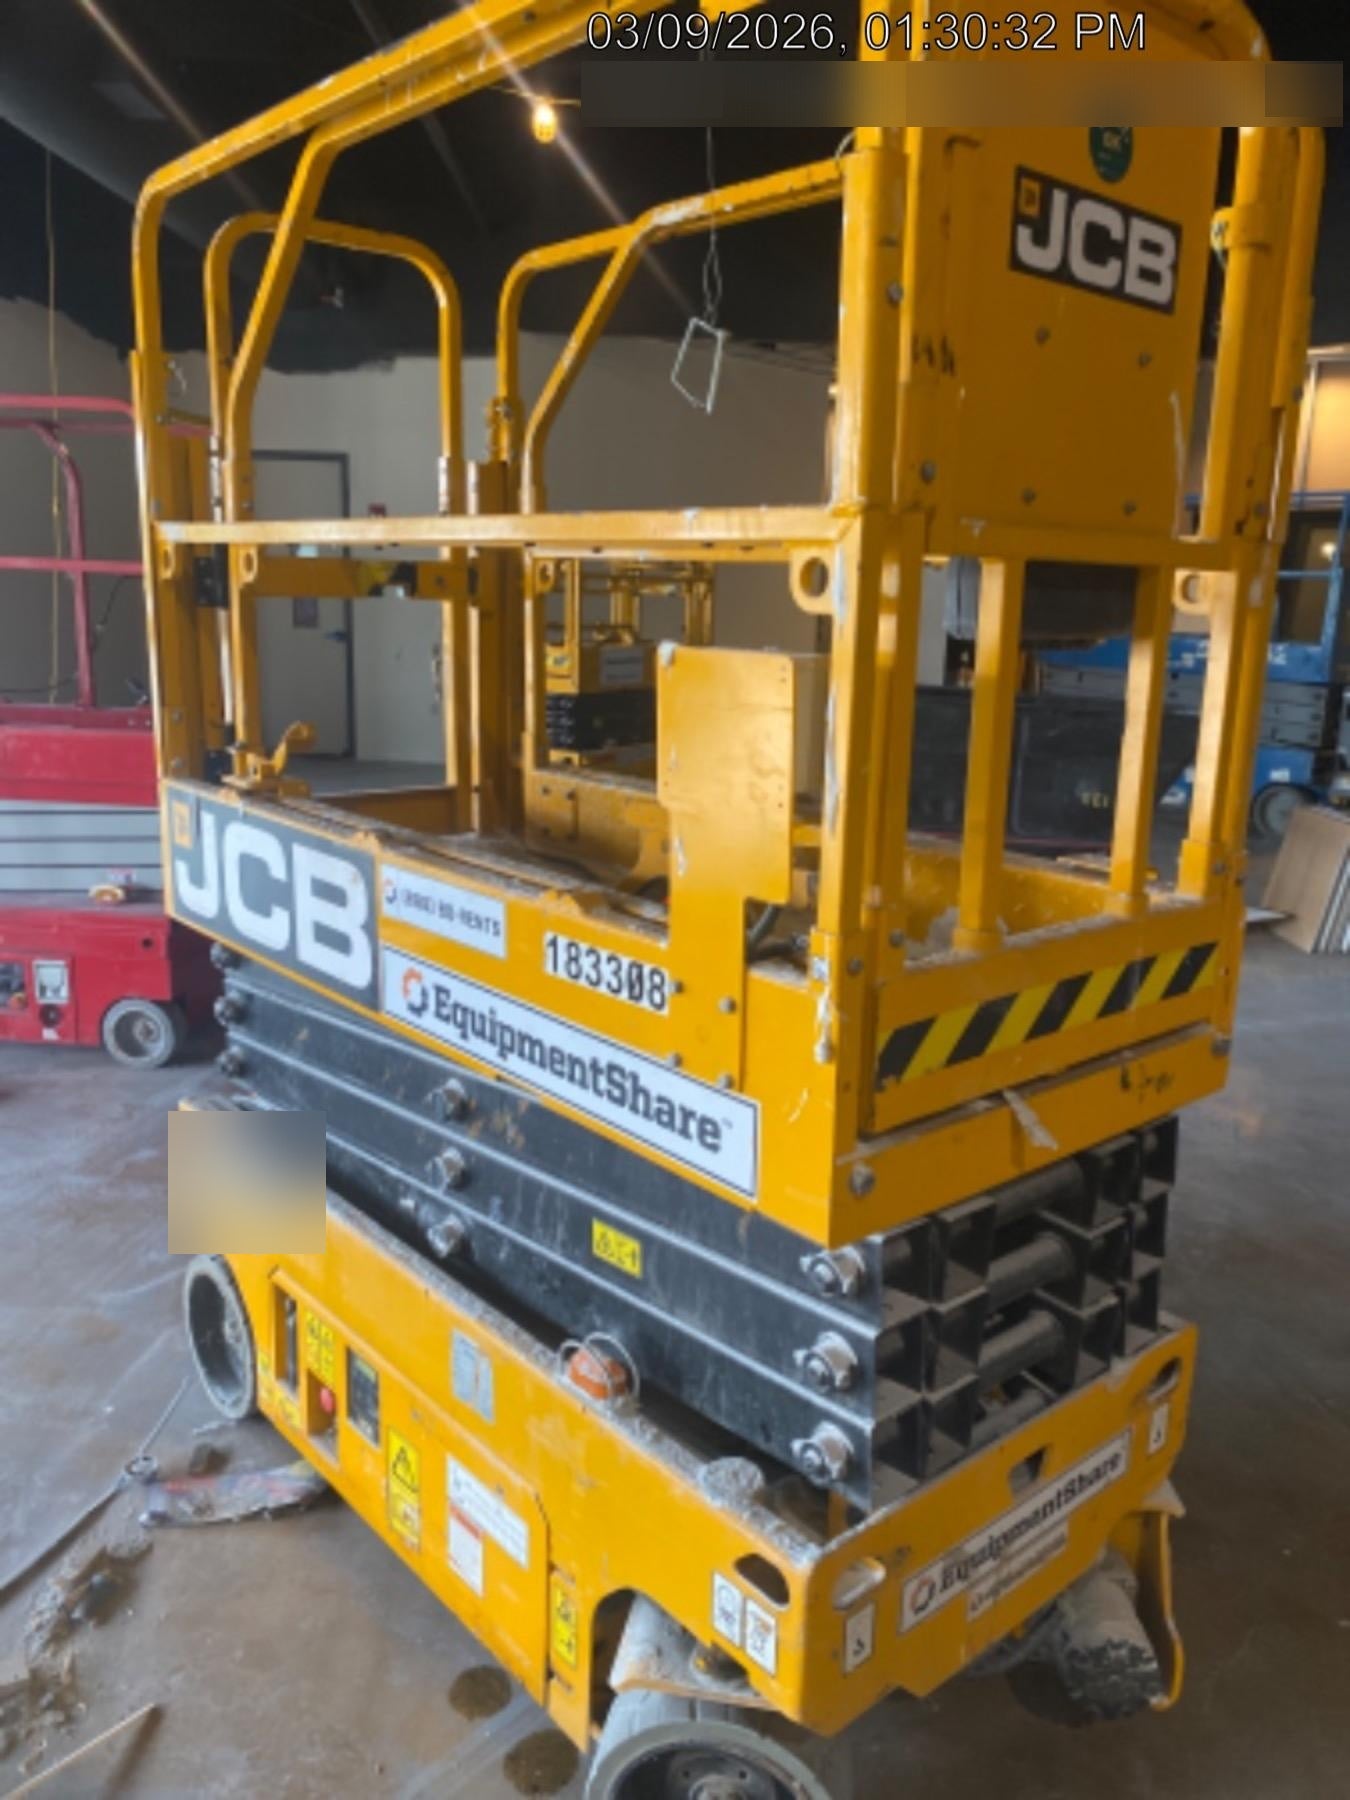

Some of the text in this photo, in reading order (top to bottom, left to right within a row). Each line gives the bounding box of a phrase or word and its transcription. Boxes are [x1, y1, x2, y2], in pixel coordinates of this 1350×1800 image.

[1015, 187, 1178, 306] JCB
[174, 810, 373, 990] JCB
[546, 935, 666, 1011] 183308
[432, 982, 722, 1155] EquipmentShare
[939, 1452, 1123, 1593] EquipmentShare
